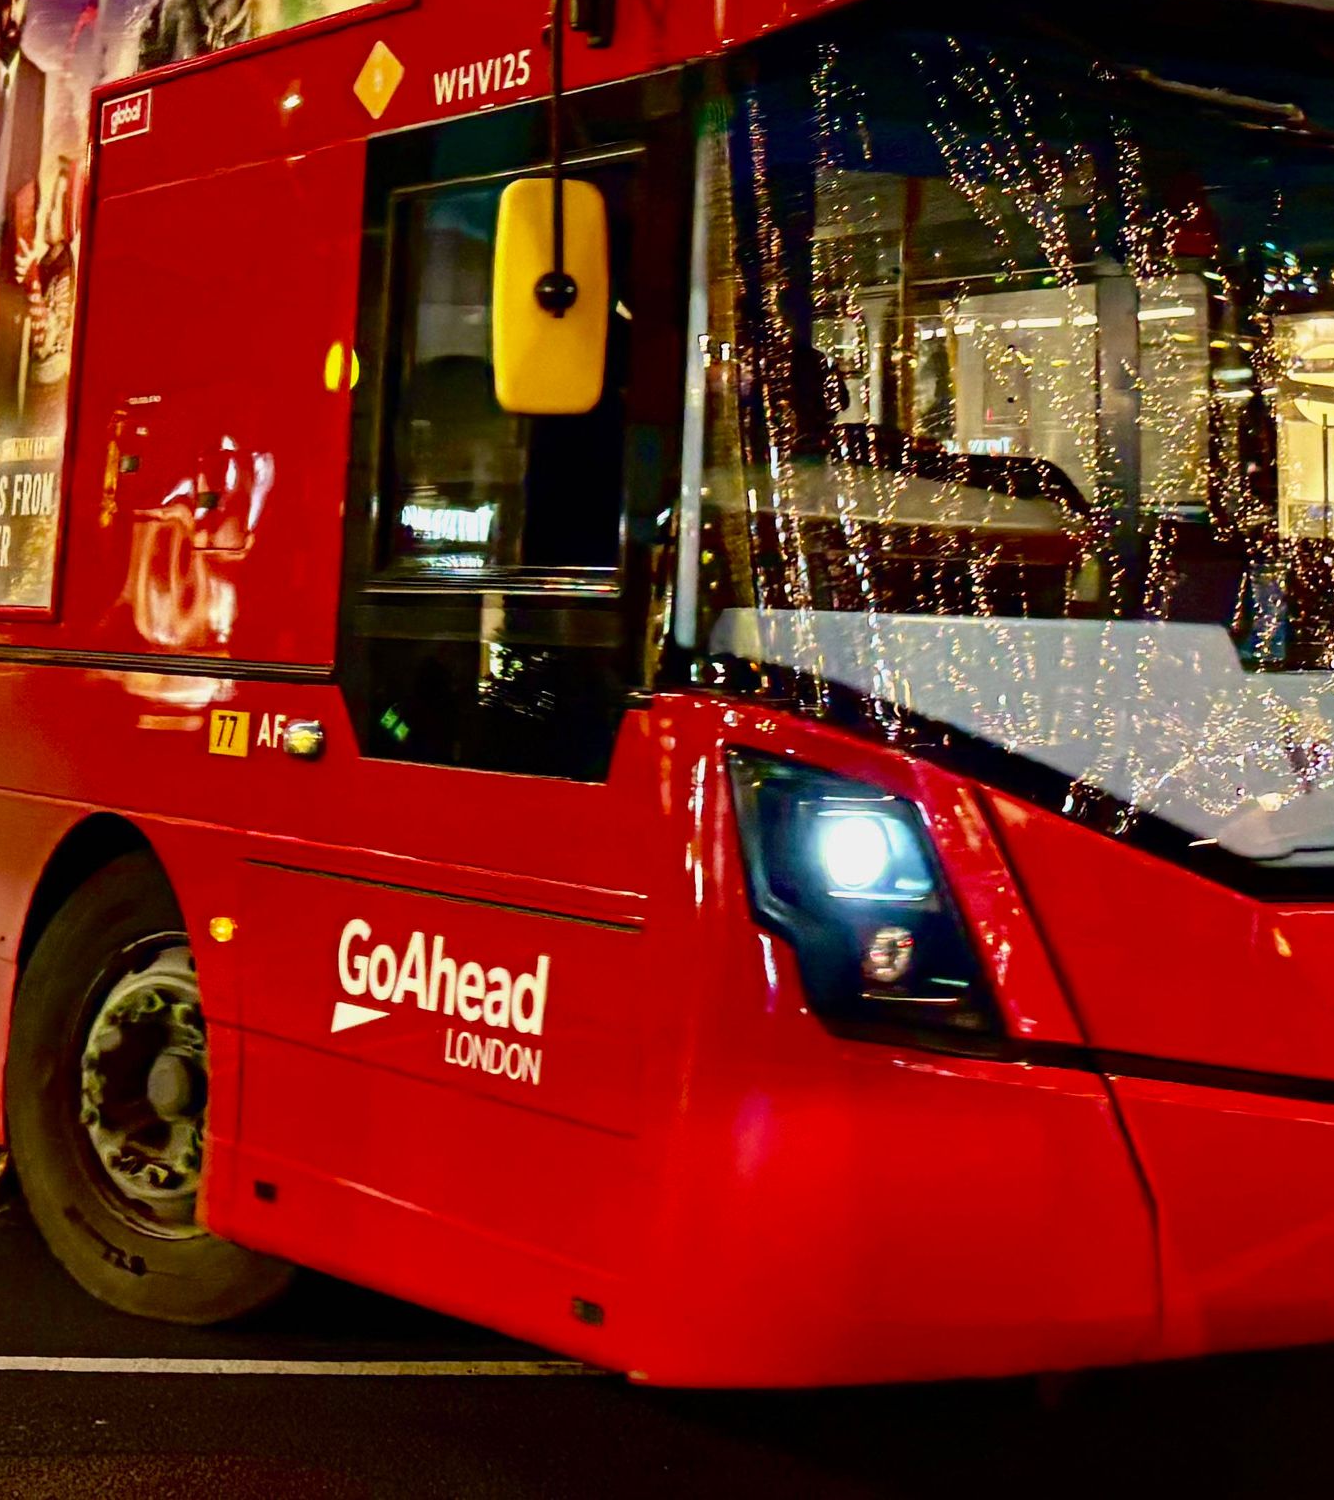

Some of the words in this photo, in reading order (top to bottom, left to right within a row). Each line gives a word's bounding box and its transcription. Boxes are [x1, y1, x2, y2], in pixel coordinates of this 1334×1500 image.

[433, 48, 532, 106] WHV125
[11, 472, 55, 516] FROM
[216, 714, 238, 748] 77
[338, 918, 551, 1036] GoAhead
[444, 1027, 543, 1085] LONDON
